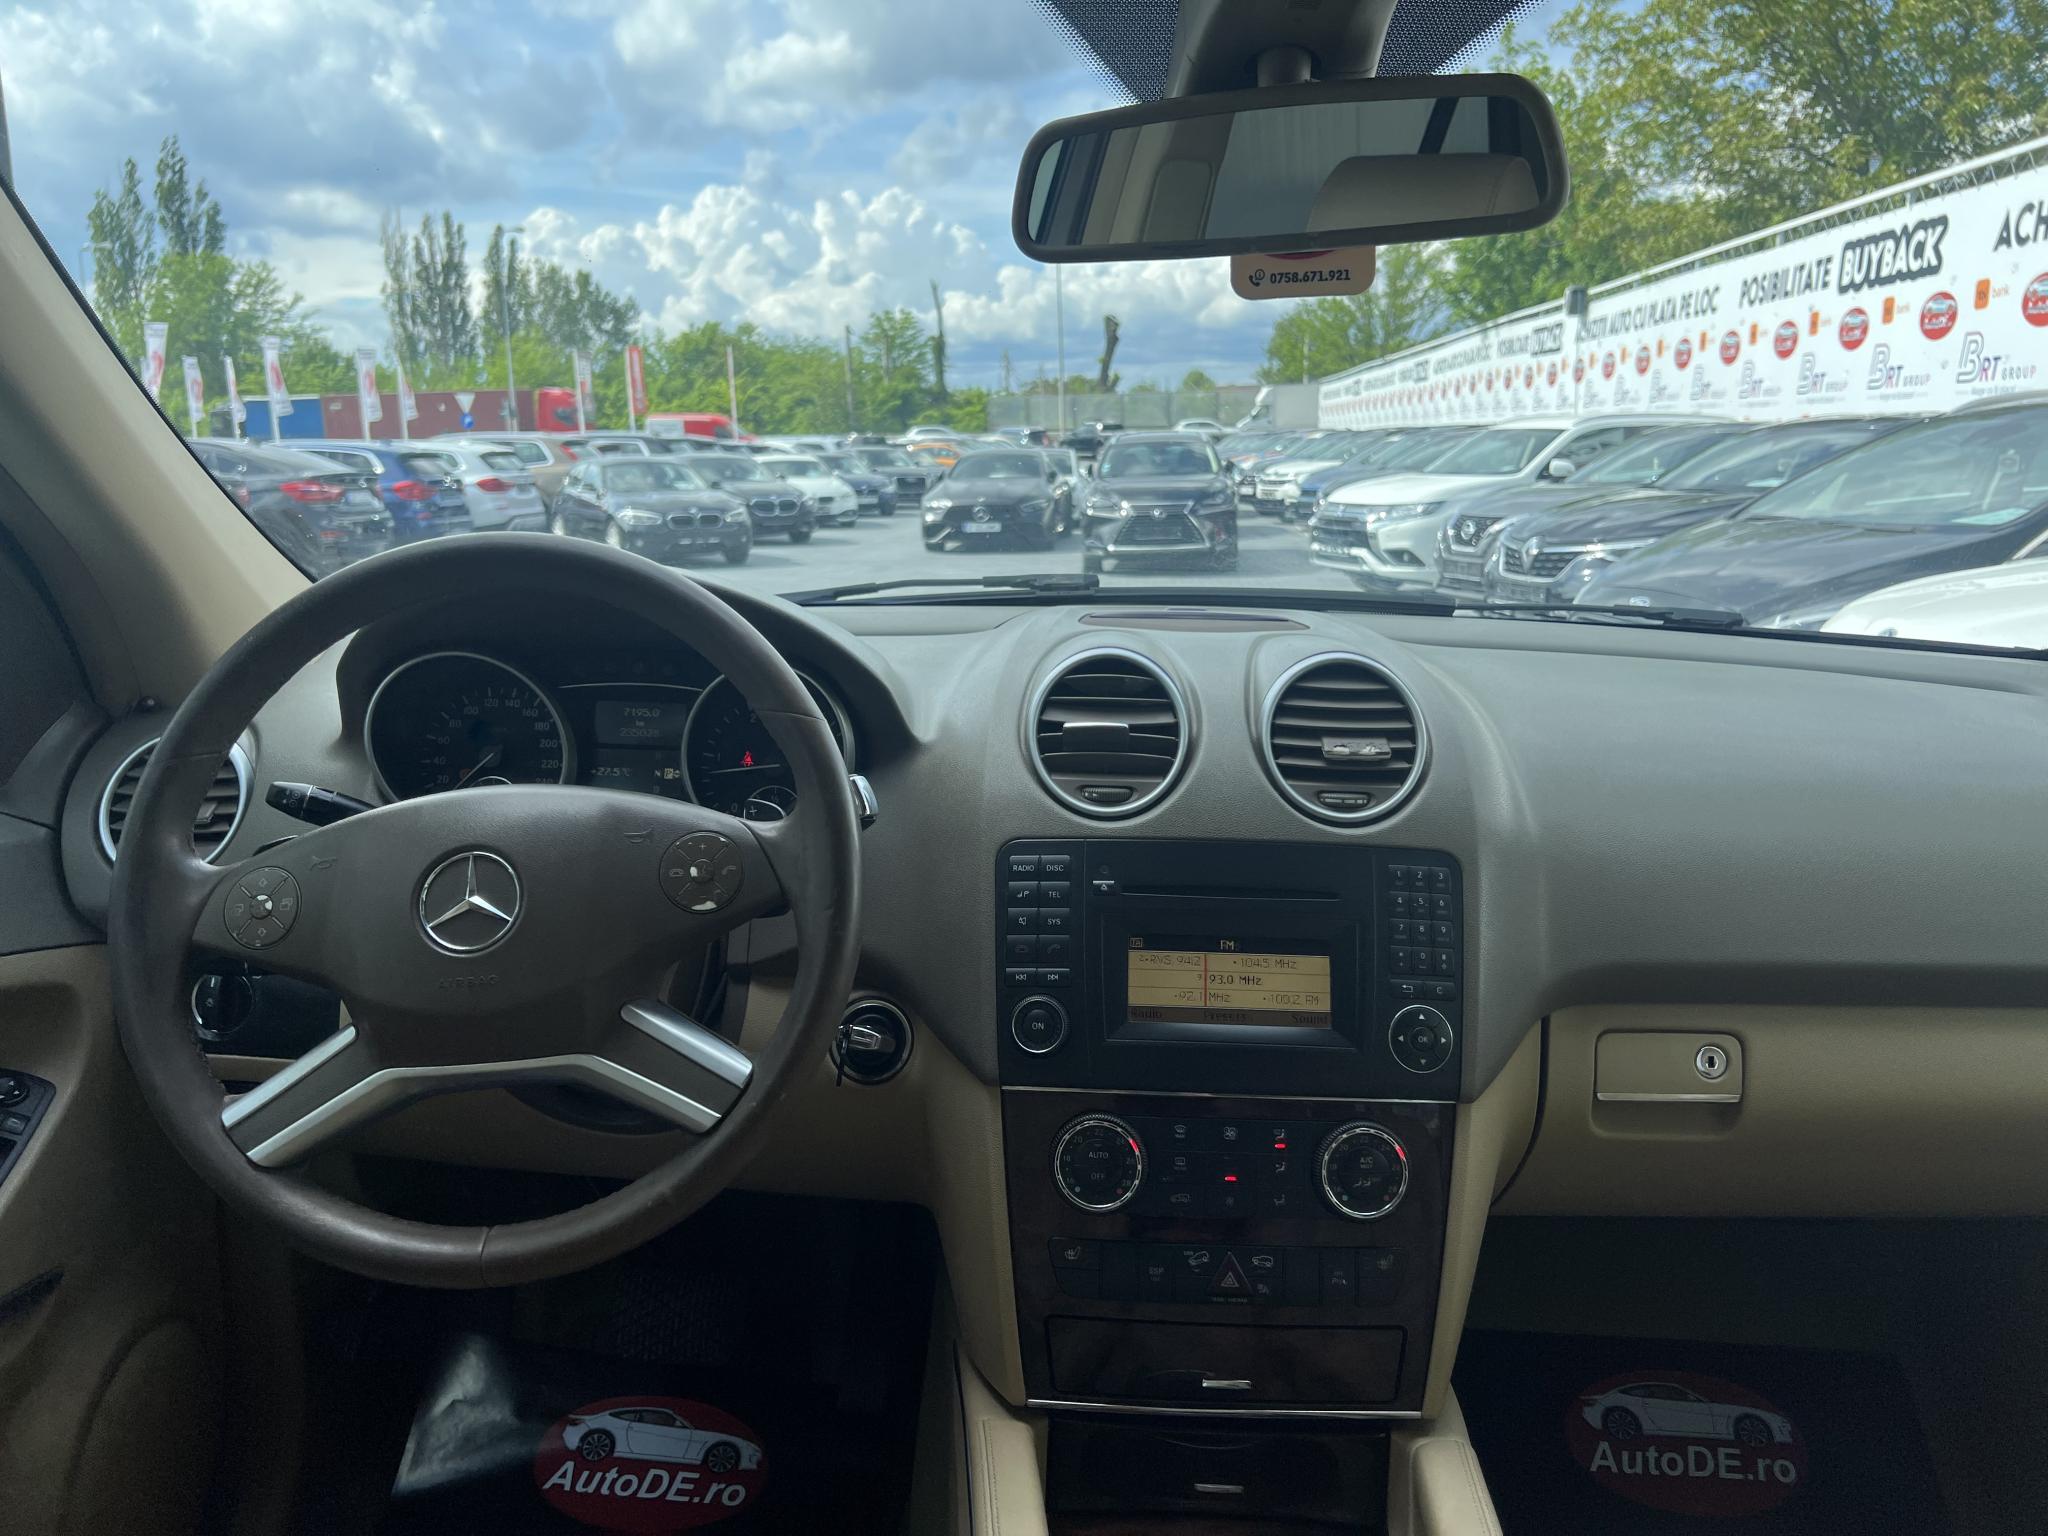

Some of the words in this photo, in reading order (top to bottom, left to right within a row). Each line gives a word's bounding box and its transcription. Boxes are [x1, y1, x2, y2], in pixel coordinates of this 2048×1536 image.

[1738, 256, 1833, 308] POSIBILITATE
[1839, 217, 1947, 292] BUYBACK
[1270, 269, 1352, 284] 0758.671.921
[1694, 285, 1720, 318] LOC
[2001, 365, 2037, 381] GROUP
[539, 739, 557, 748] 200
[541, 760, 559, 768] 220
[1012, 864, 1035, 872] RADIO
[1046, 864, 1064, 872] DISC
[1047, 918, 1061, 926] SYS
[1220, 939, 1235, 950] FM
[1241, 957, 1270, 968] 104.5
[1274, 959, 1297, 969] MHz
[1209, 974, 1234, 985] 93.0
[1239, 976, 1263, 986] MHz
[1209, 992, 1230, 1003] MHz
[1031, 1022, 1045, 1030] ON
[1418, 1035, 1428, 1043] OK
[1589, 1440, 1796, 1484] AutoDE.ro
[543, 1460, 746, 1507] AutoDE.ro
